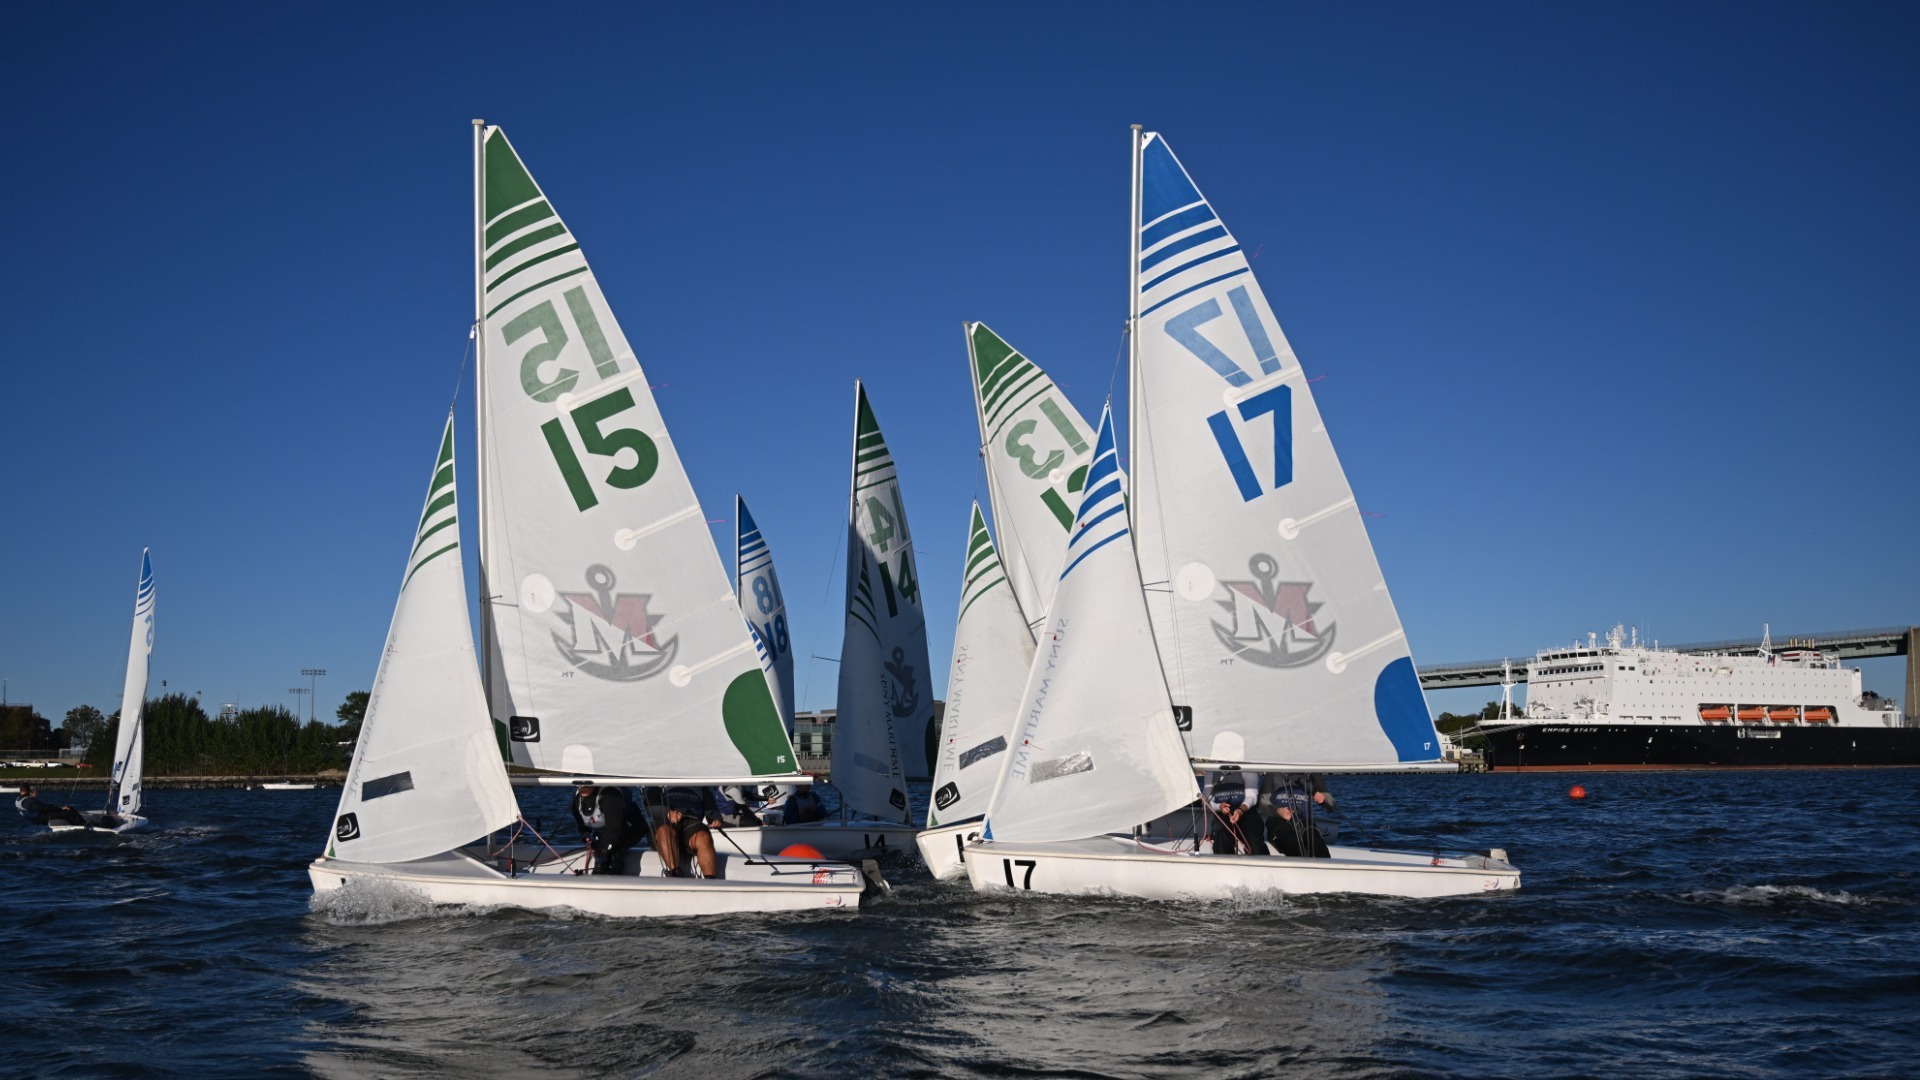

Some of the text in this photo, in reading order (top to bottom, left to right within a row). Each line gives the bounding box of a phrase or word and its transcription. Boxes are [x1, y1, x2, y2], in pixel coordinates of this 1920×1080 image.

[540, 387, 659, 513] 15
[1206, 384, 1292, 503] 17
[1040, 464, 1090, 534] 1
[878, 551, 917, 618] 14
[764, 614, 788, 662] 18
[777, 755, 786, 763] 15
[1003, 859, 1036, 889] 17
